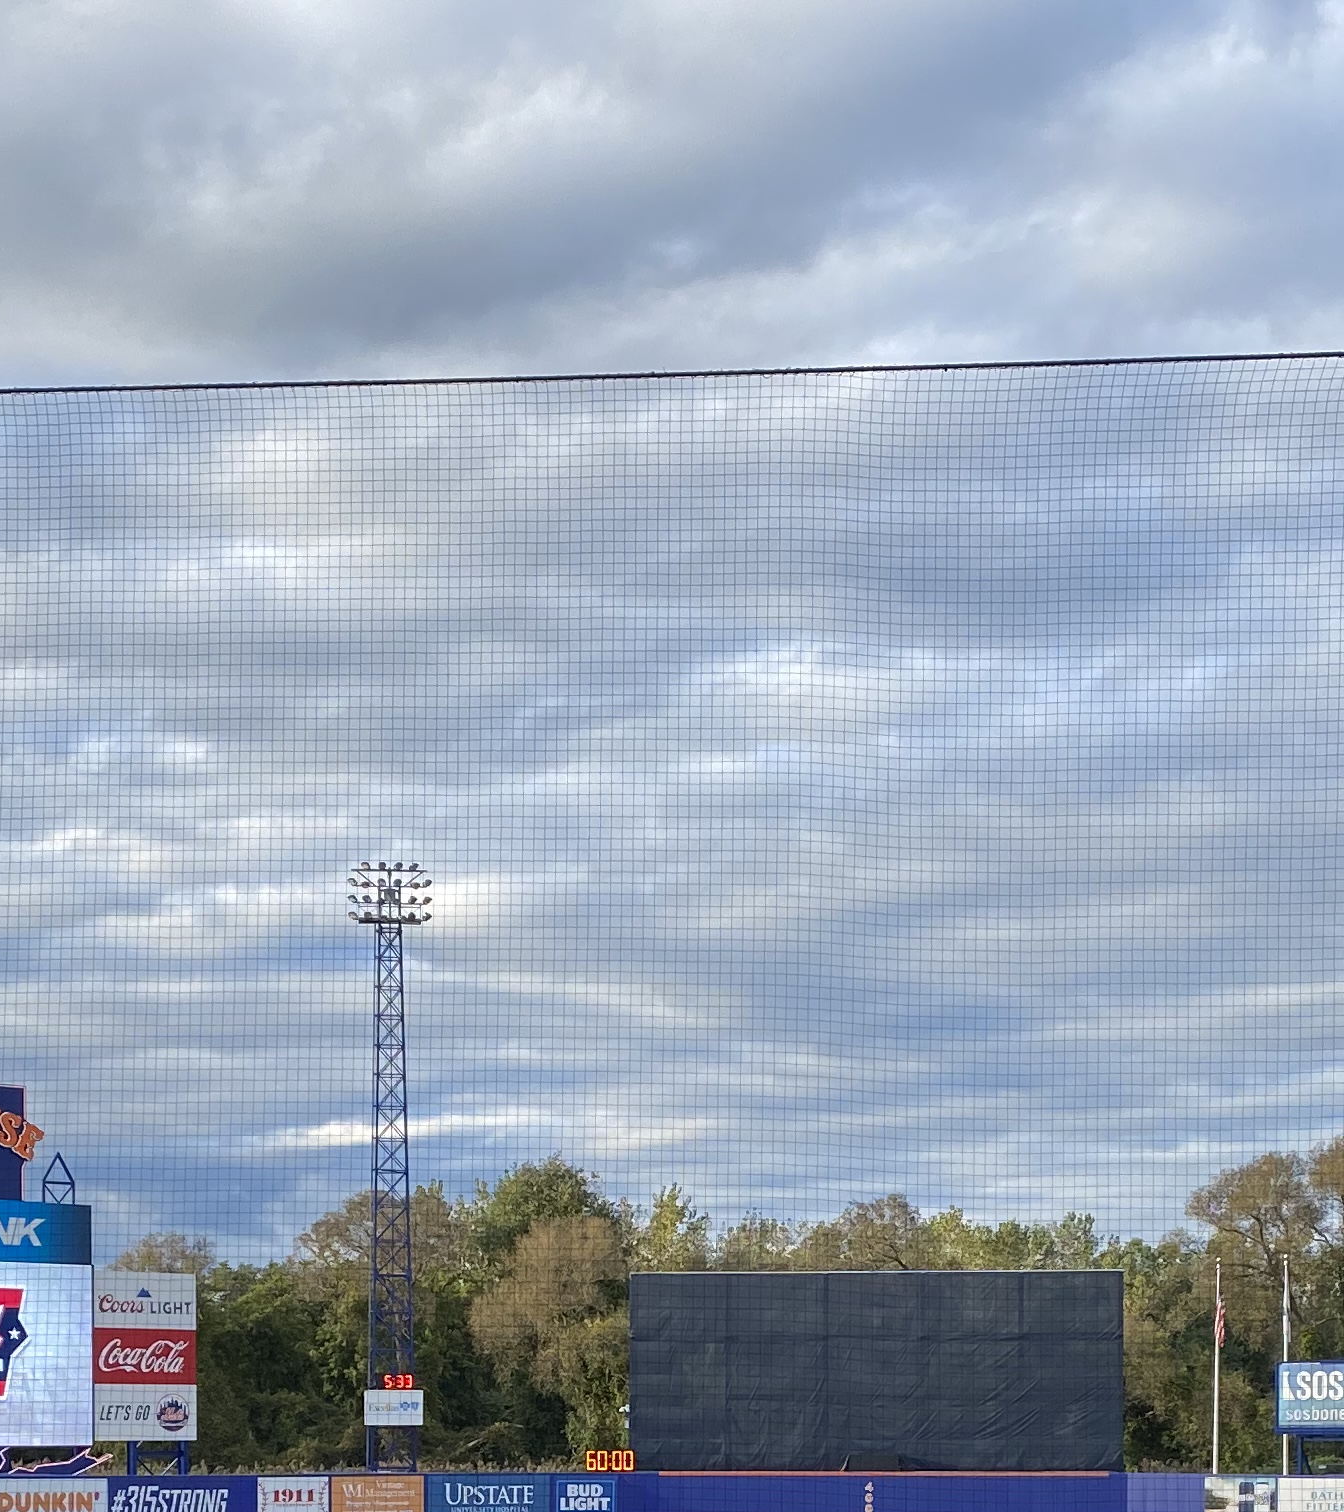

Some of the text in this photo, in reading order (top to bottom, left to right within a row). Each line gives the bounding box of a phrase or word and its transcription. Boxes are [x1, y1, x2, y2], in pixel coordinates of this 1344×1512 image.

[98, 1293, 192, 1315] Coors LIGHT
[99, 1338, 190, 1374] Coca-Cola
[1296, 1370, 1344, 1401] SOS
[100, 1405, 131, 1421] LET'S
[135, 1405, 151, 1421] GO
[586, 1450, 634, 1471] 60:00
[273, 1488, 315, 1503] 1911
[444, 1483, 534, 1505] UPSTATE
[567, 1484, 604, 1497] BUD
[1311, 1491, 1344, 1500] BATH
[560, 1498, 611, 1511] LIGHT
